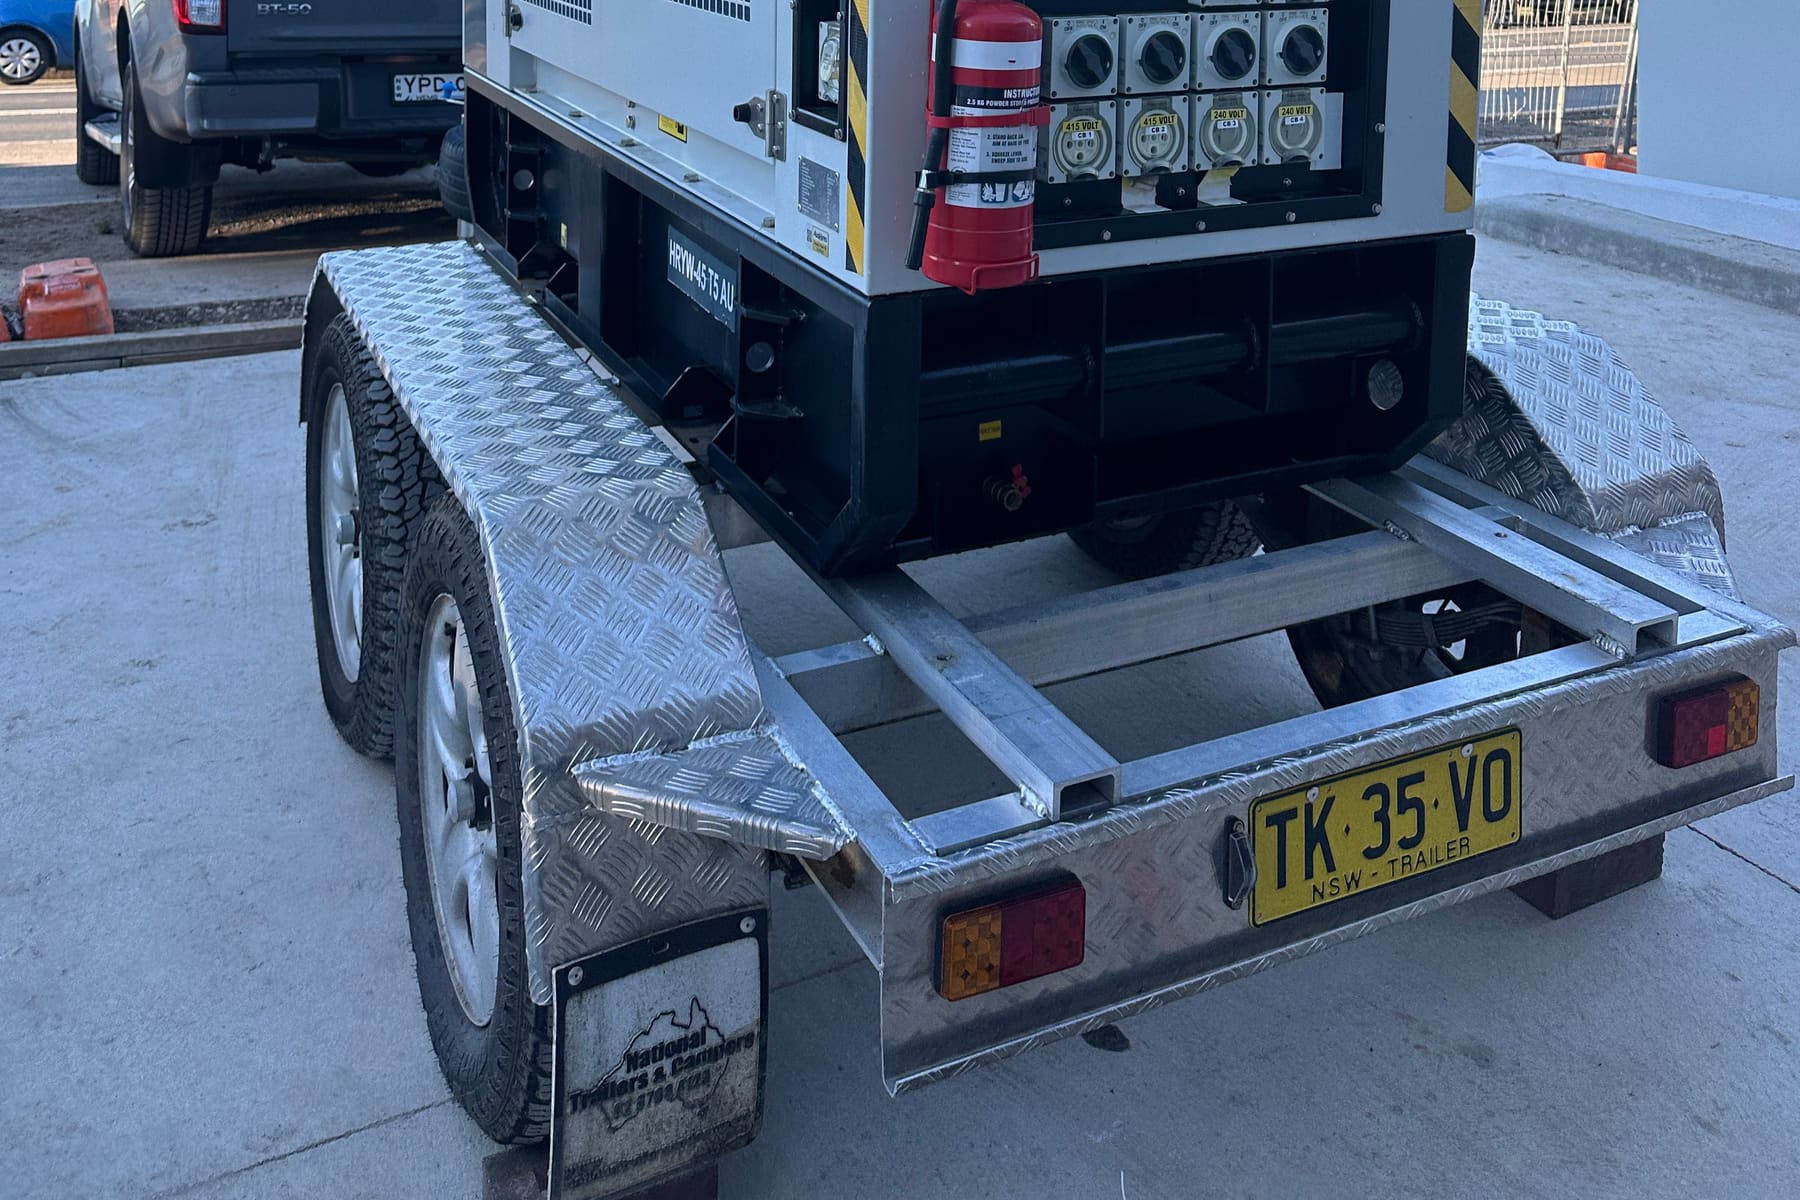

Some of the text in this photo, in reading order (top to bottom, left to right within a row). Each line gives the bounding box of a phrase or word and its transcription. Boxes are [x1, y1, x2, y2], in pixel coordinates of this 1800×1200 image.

[257, 3, 312, 15] BT-50
[404, 76, 446, 93] YPD
[1213, 110, 1245, 119] 240 VOLT
[1281, 106, 1311, 116] 240 VOLT
[1065, 121, 1099, 130] 415 VOLT
[1143, 116, 1175, 126] 415 VOLT
[669, 239, 734, 313] HRYW-45 T5 AU
[1265, 748, 1512, 890] TK 35 VO
[1312, 870, 1362, 903] NSW
[1387, 836, 1470, 878] TRAILER
[626, 1026, 707, 1073] National
[569, 1072, 649, 1115] Trailers
[652, 1066, 666, 1084] &
